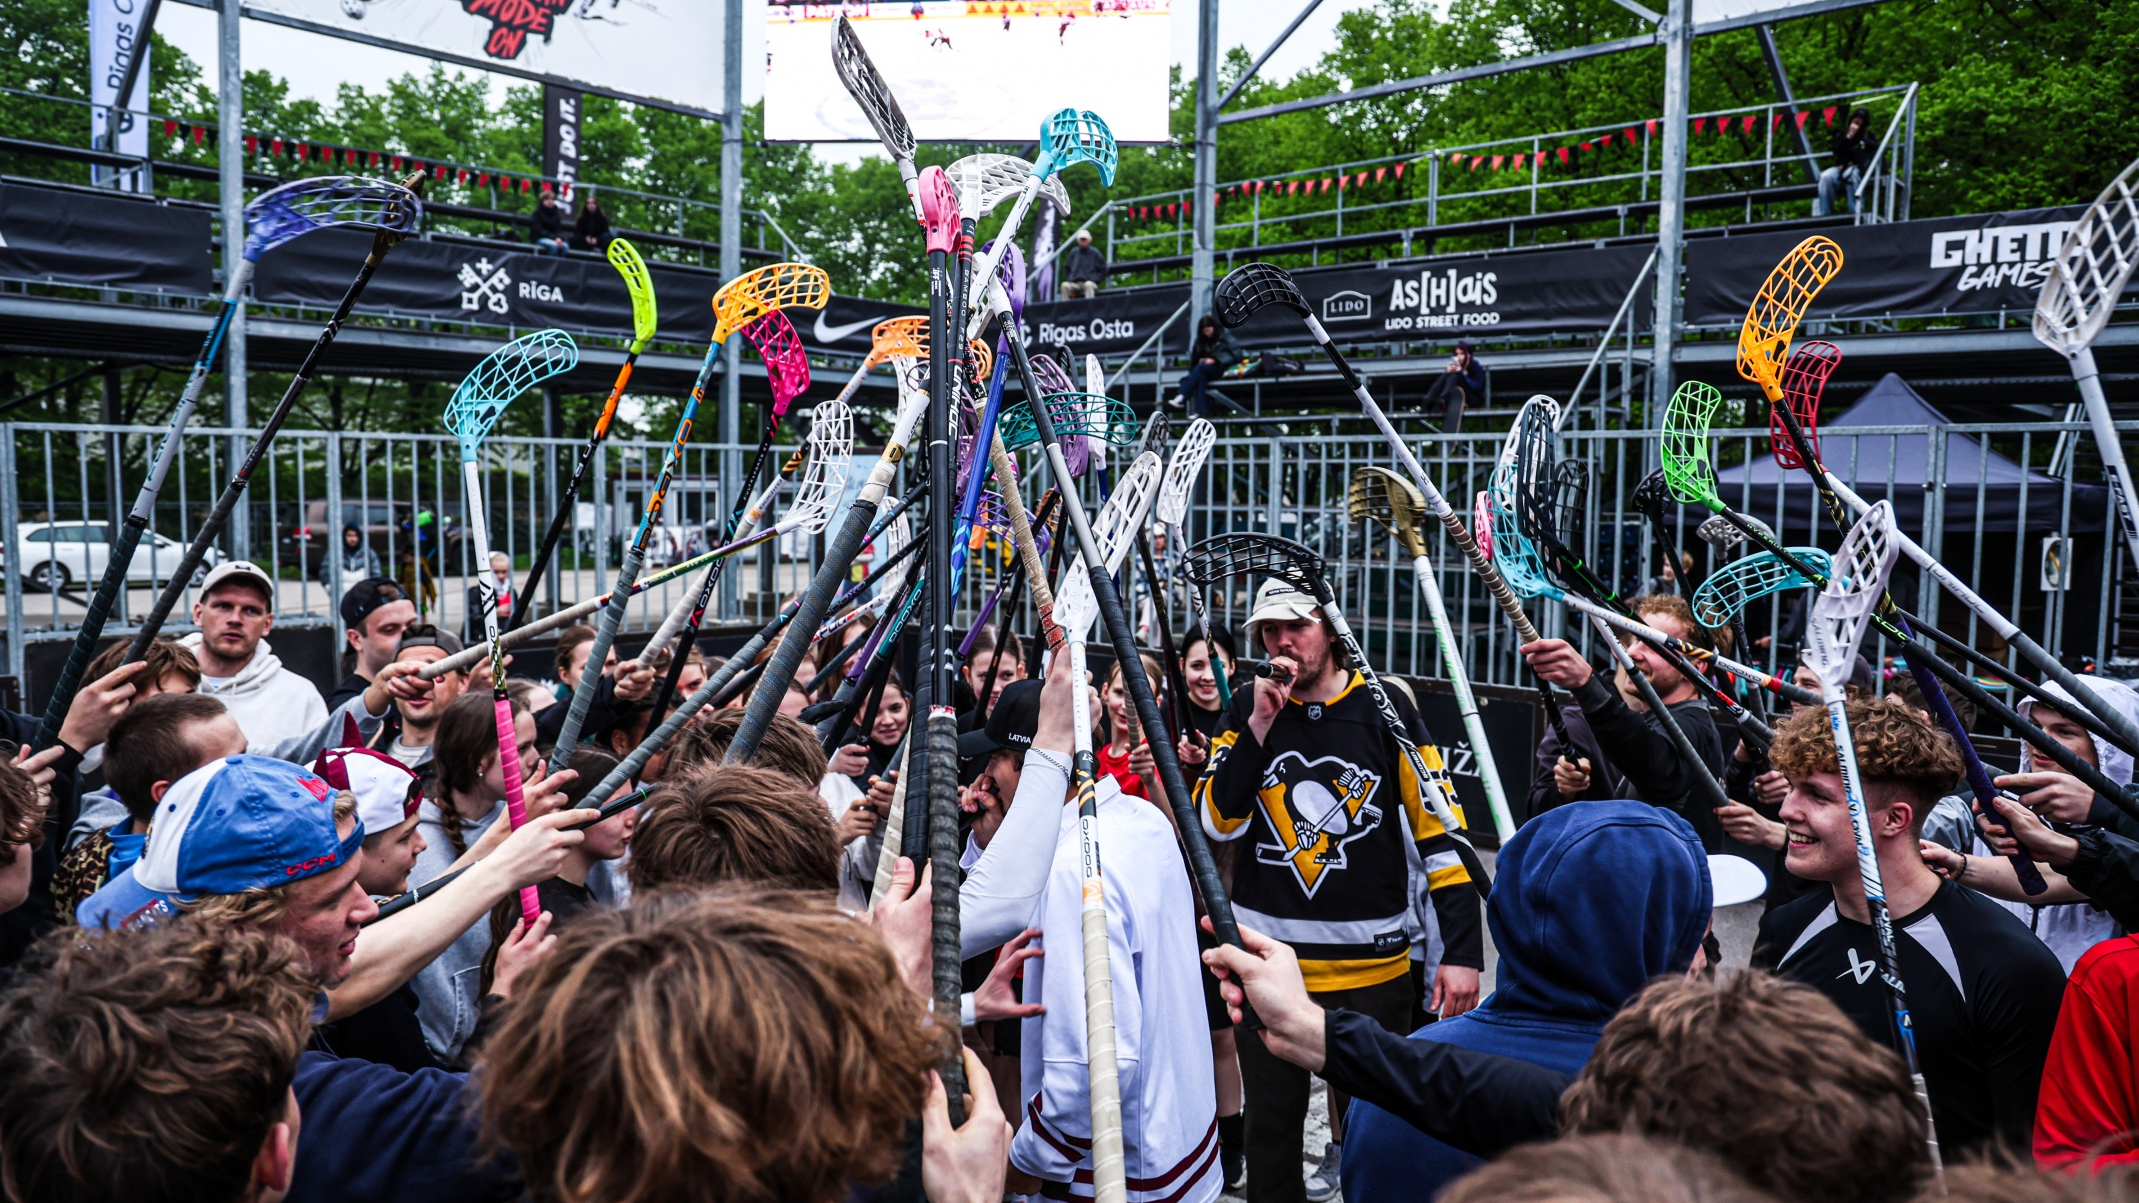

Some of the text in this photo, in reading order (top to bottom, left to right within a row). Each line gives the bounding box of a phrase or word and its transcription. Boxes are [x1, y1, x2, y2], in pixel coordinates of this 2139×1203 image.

[487, 27, 526, 58] ON
[559, 124, 576, 158] DO
[518, 280, 565, 303] RĪGA
[961, 269, 970, 317] BAMBOO
[1330, 299, 1365, 313] LIDO
[1090, 318, 1134, 340] Osta
[1385, 312, 1500, 330] LIDO STREET FOOD
[949, 364, 963, 441] UNIHOC
[889, 588, 923, 644] OXDOG
[489, 625, 503, 690] OXDOG
[1718, 660, 1763, 682] OXDOG
[1008, 732, 1032, 744] LATVIA
[1082, 818, 1093, 878] OXDOG
[286, 853, 336, 876] CCM
